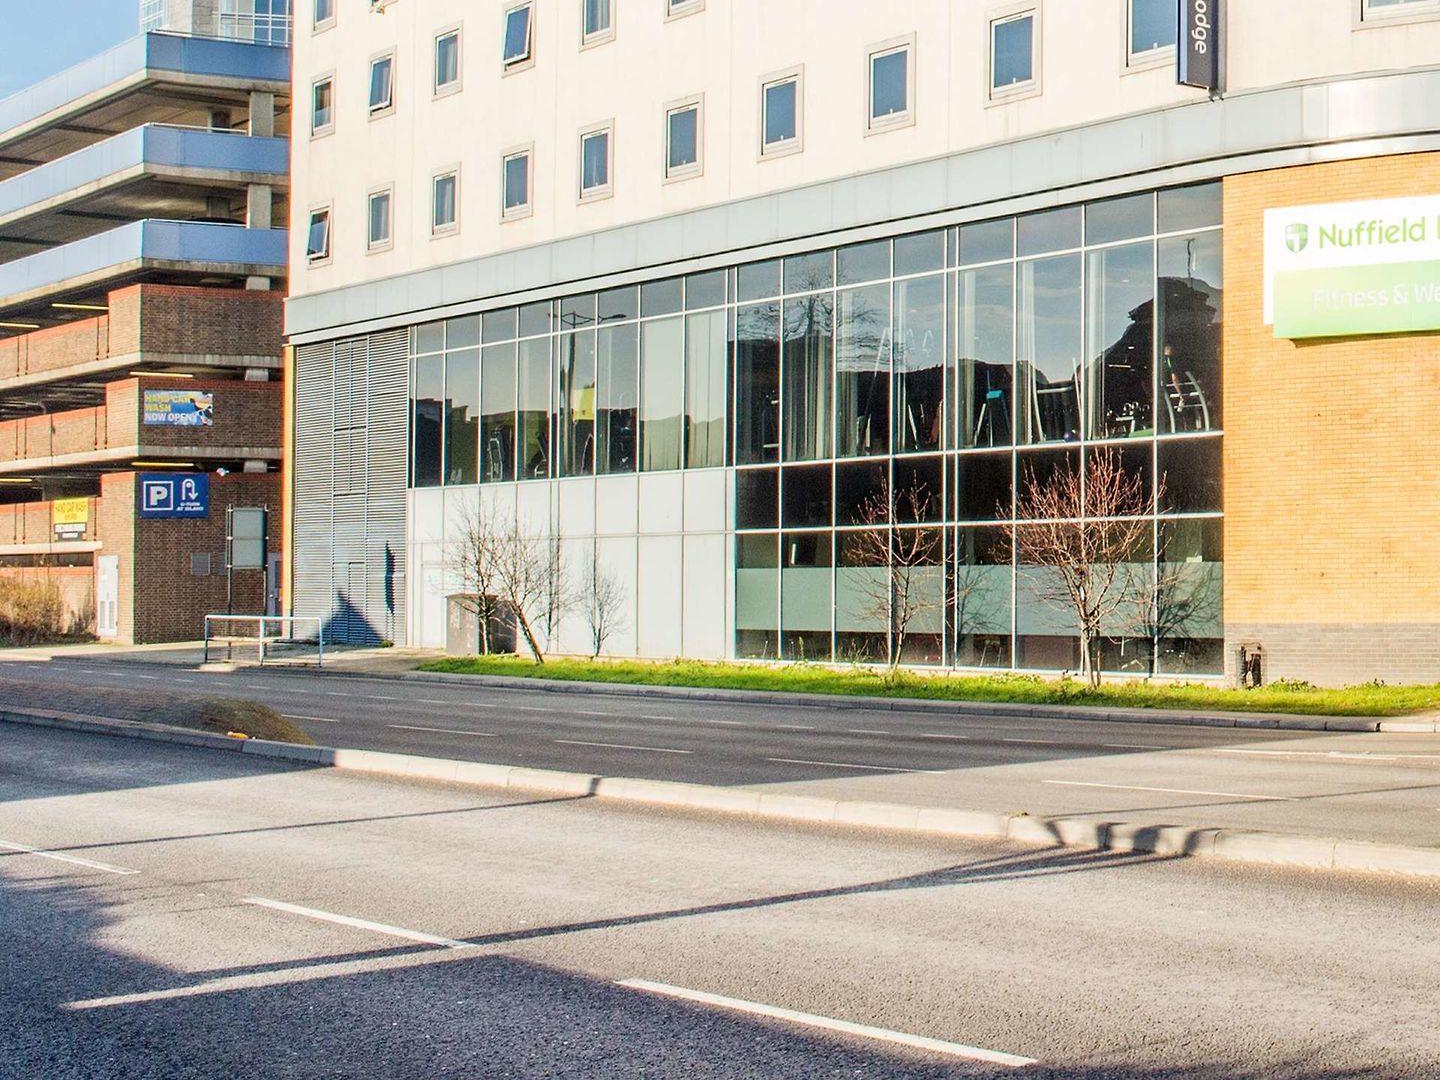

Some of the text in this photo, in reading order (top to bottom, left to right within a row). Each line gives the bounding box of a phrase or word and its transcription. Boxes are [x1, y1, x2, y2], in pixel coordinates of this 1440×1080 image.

[1319, 216, 1426, 249] Nuffield
[1312, 286, 1388, 311] Fitness
[1392, 284, 1408, 305] &
[144, 412, 166, 421] NOW
[149, 485, 168, 506] P
